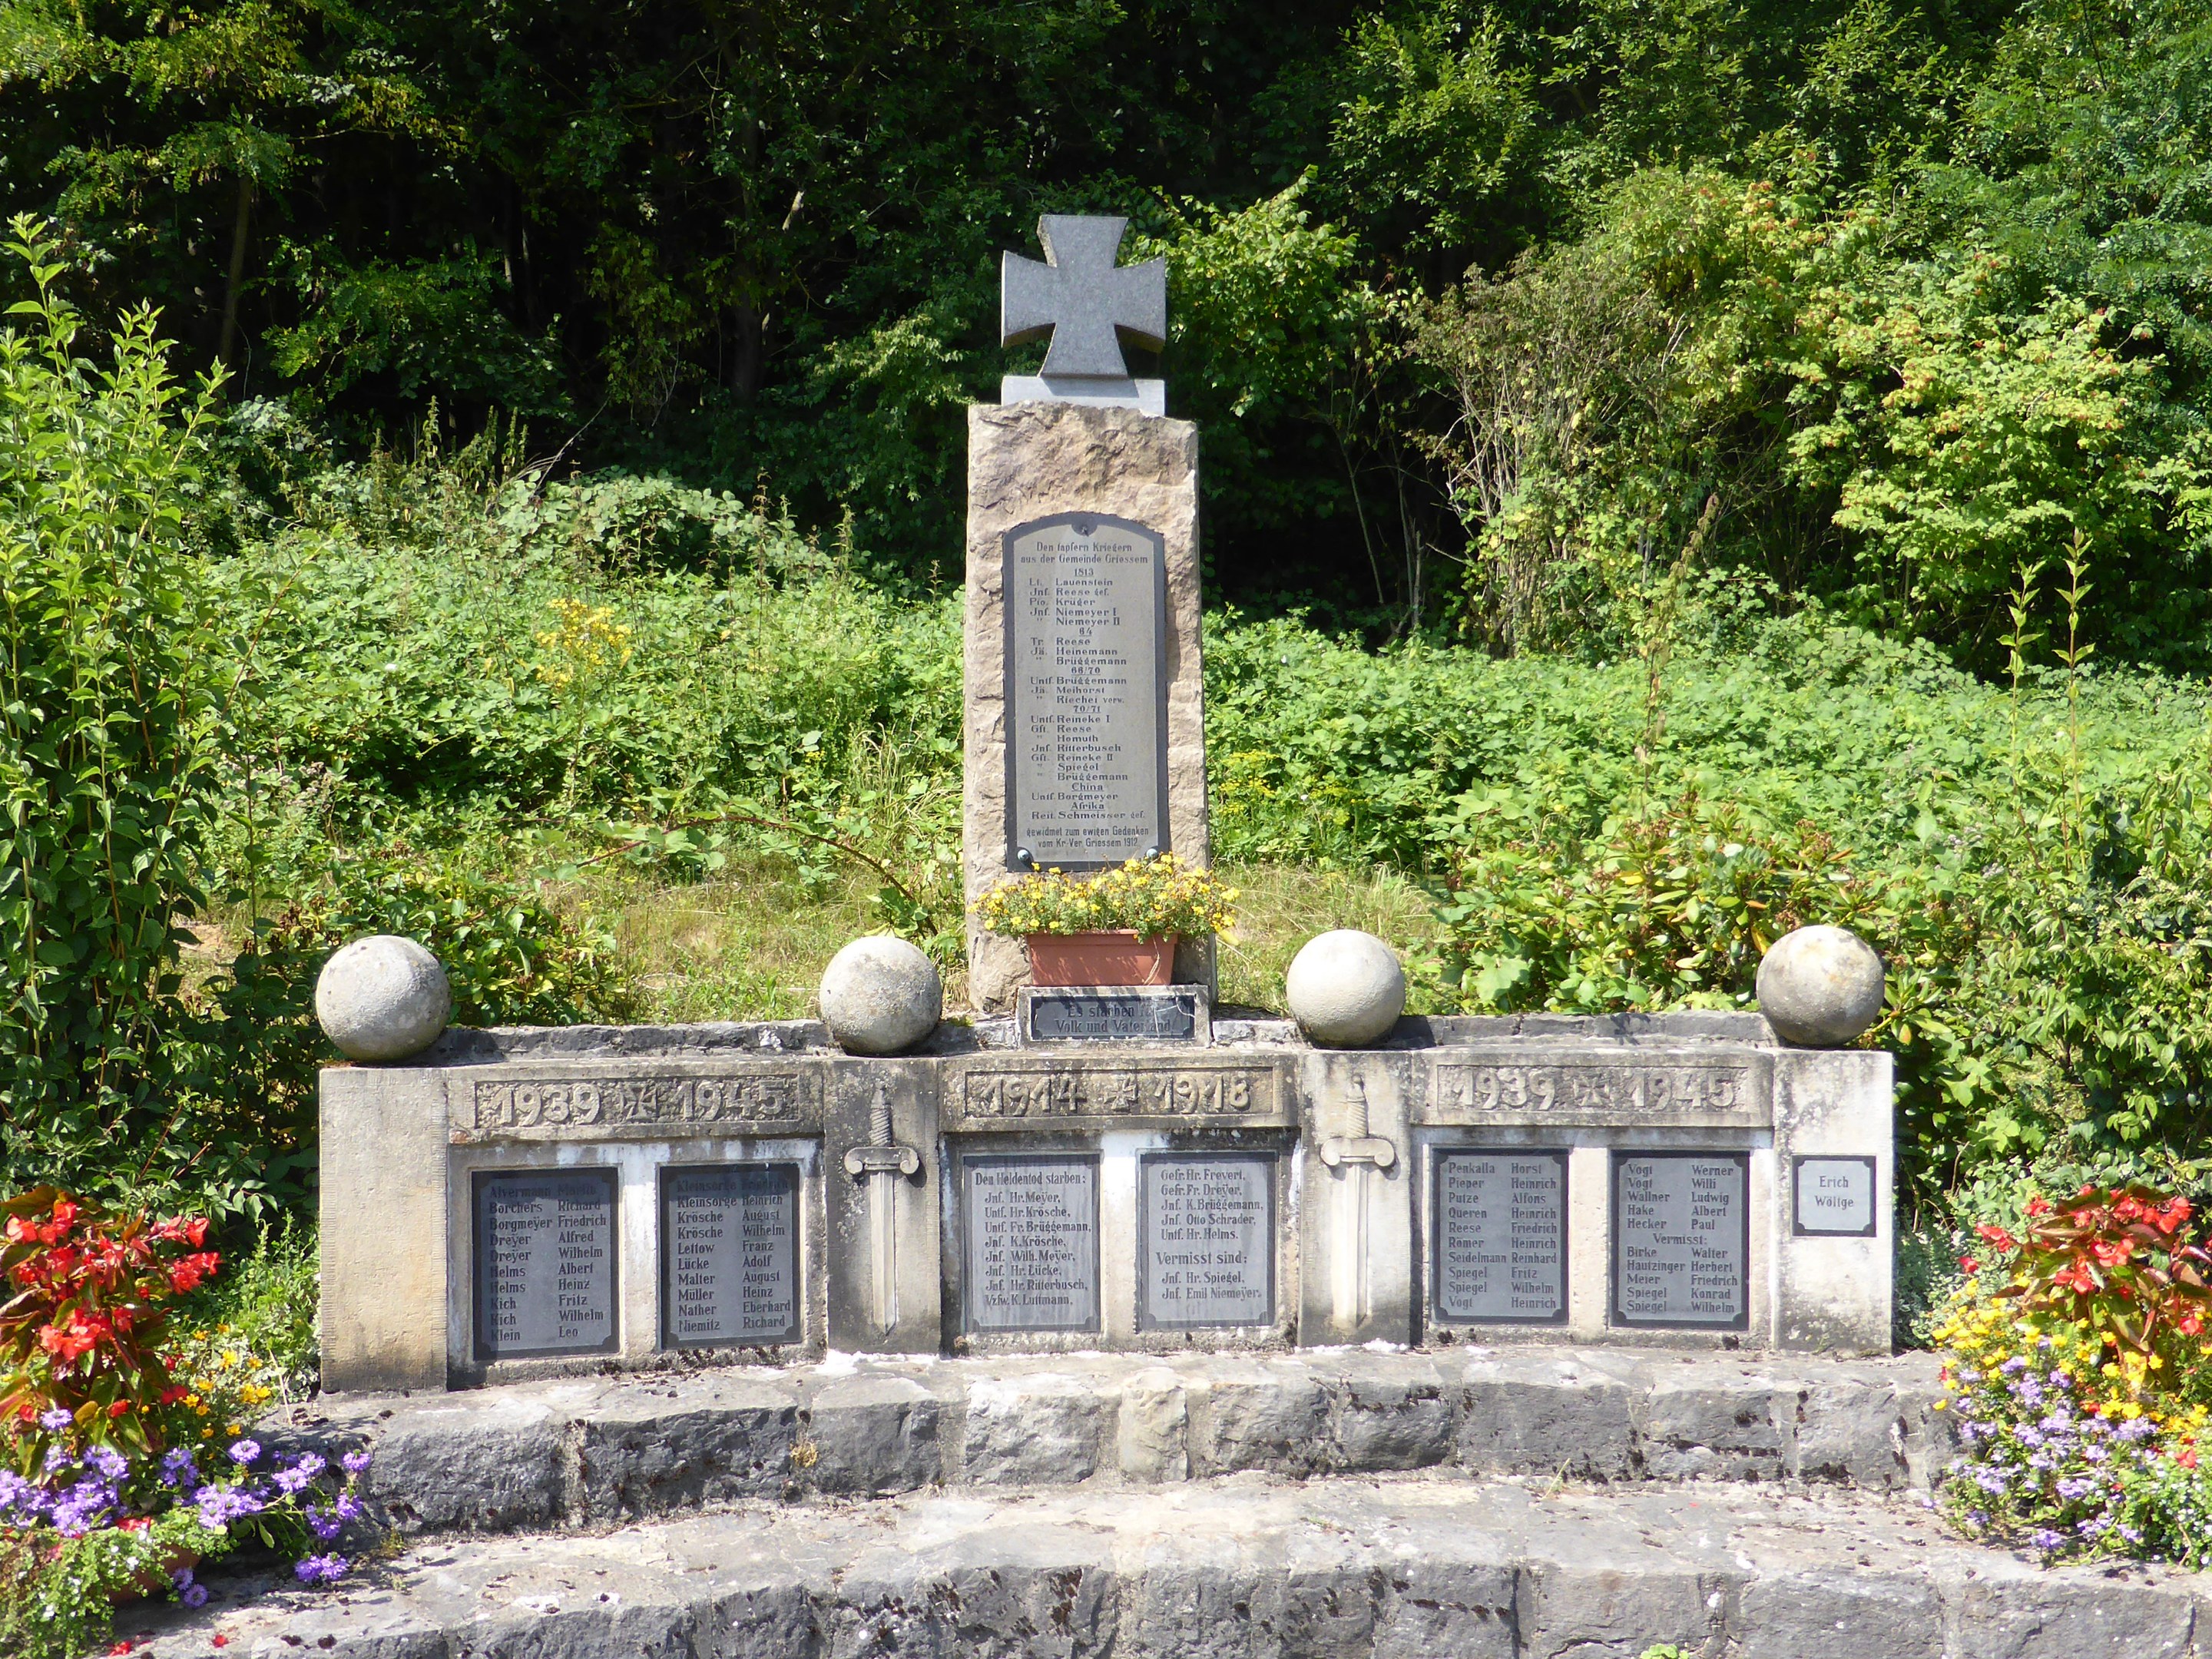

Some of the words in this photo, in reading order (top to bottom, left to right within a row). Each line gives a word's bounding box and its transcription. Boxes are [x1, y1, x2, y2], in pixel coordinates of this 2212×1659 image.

[1037, 542, 1054, 551] Den
[1040, 555, 1055, 563] der
[1059, 555, 1101, 563] Gemeinde
[1074, 568, 1094, 577] 1813
[1056, 598, 1096, 607] Krüger
[1056, 608, 1110, 618] Niemeyer
[1056, 618, 1110, 627] Niemeyer
[1056, 657, 1127, 666] Brüggemann
[1057, 677, 1127, 686] Brüggemann
[1058, 763, 1098, 772] Spiegel
[1058, 773, 1128, 782] Brüggemann
[1071, 782, 1104, 790] China
[1027, 827, 1062, 836] gewidmet
[1083, 827, 1109, 837] ewigen
[1112, 826, 1149, 836] Gedenken
[1086, 838, 1121, 846] Griessem
[1055, 1020, 1081, 1033] Volk
[1087, 1020, 1108, 1032] und
[979, 1076, 1087, 1116] 1914
[1153, 1075, 1250, 1114] 1918
[1452, 1068, 1558, 1111] 1939
[1623, 1071, 1735, 1111] 1945
[496, 1082, 601, 1126] 1939
[674, 1079, 786, 1120] 1945
[1449, 1163, 1495, 1174] Penkalla
[1511, 1163, 1541, 1174] Horst
[1628, 1164, 1652, 1176] Vogt
[1692, 1165, 1734, 1176] Werner
[975, 1174, 994, 1185] Den
[997, 1172, 1042, 1185] Heldentod
[1045, 1171, 1086, 1184] starben:
[1449, 1177, 1484, 1189] Pieper
[1511, 1178, 1556, 1188] Heinrich
[1628, 1178, 1652, 1190] Vogt
[1692, 1178, 1716, 1189] Willi
[1819, 1176, 1849, 1187] Erich
[1449, 1193, 1479, 1203] Putze
[1512, 1194, 1546, 1204] Alfons
[1628, 1191, 1671, 1202] Wallner
[1691, 1192, 1729, 1205] Ludwig
[1814, 1195, 1854, 1209] Wöltge
[489, 1203, 542, 1214] Borchers
[558, 1200, 601, 1211] Richard
[1449, 1207, 1487, 1218] Queren
[1511, 1208, 1556, 1219] Heinrich
[1628, 1205, 1654, 1215] Hake
[1691, 1206, 1727, 1216] Albert
[558, 1215, 606, 1227] Friedrich
[677, 1211, 724, 1223] Krösche
[742, 1210, 780, 1221] August
[1186, 1214, 1206, 1224] Otto
[1449, 1222, 1481, 1233] Reese
[1511, 1223, 1557, 1233] Friedrich
[1628, 1219, 1667, 1229] Hecker
[1690, 1220, 1714, 1230] Paul
[558, 1230, 594, 1243] Alfred
[677, 1226, 724, 1239] Krösche
[743, 1225, 785, 1237] Wilhelm
[1511, 1237, 1556, 1248] Heinrich
[1653, 1233, 1707, 1245] Vermisst:
[559, 1247, 602, 1259] Wilhelm
[678, 1243, 715, 1254] Lettow
[742, 1240, 773, 1252] Franz
[1628, 1247, 1657, 1257] Birke
[1691, 1248, 1728, 1258] Walter
[678, 1258, 710, 1270] Lücke
[743, 1256, 772, 1267] Adolf
[1157, 1252, 1211, 1264] Vermisst
[1217, 1251, 1247, 1263] sind:
[1449, 1253, 1506, 1263] Seidelmann
[1511, 1253, 1556, 1263] Reinhard
[490, 1266, 526, 1278] Helms
[558, 1263, 593, 1274] Albert
[1628, 1260, 1685, 1273] Hautzinger
[1691, 1262, 1732, 1272] Herbert
[678, 1273, 716, 1285] Malter
[743, 1270, 780, 1283] August
[1449, 1267, 1487, 1280] Spiegel
[1511, 1267, 1537, 1278] Fritz
[490, 1282, 526, 1293] Helms
[558, 1279, 590, 1290] Heinz
[1628, 1274, 1661, 1284] Meier
[1690, 1275, 1737, 1286] Friedrich
[678, 1289, 714, 1301] Müller
[743, 1287, 773, 1298] Heinz
[1186, 1287, 1207, 1300] Emil
[1449, 1282, 1487, 1294] Spiegel
[1511, 1282, 1554, 1293] Wilhelm
[1628, 1287, 1667, 1300] Spiegel
[1690, 1289, 1730, 1299] Konrad
[491, 1297, 516, 1309] Kich
[558, 1295, 588, 1306] Fritz
[678, 1304, 717, 1316] Nather
[743, 1300, 790, 1313] Eberhard
[1449, 1296, 1472, 1310] Vogt
[1511, 1297, 1556, 1308] Heinrich
[1628, 1301, 1667, 1313] Spiegel
[1690, 1302, 1735, 1313] Wilhelm
[491, 1313, 516, 1325] Kich
[558, 1310, 604, 1321] Wilhelm
[679, 1320, 720, 1332] Niemitz
[743, 1316, 785, 1329] Richard
[491, 1329, 520, 1341] Klein
[558, 1326, 578, 1337] Leo
